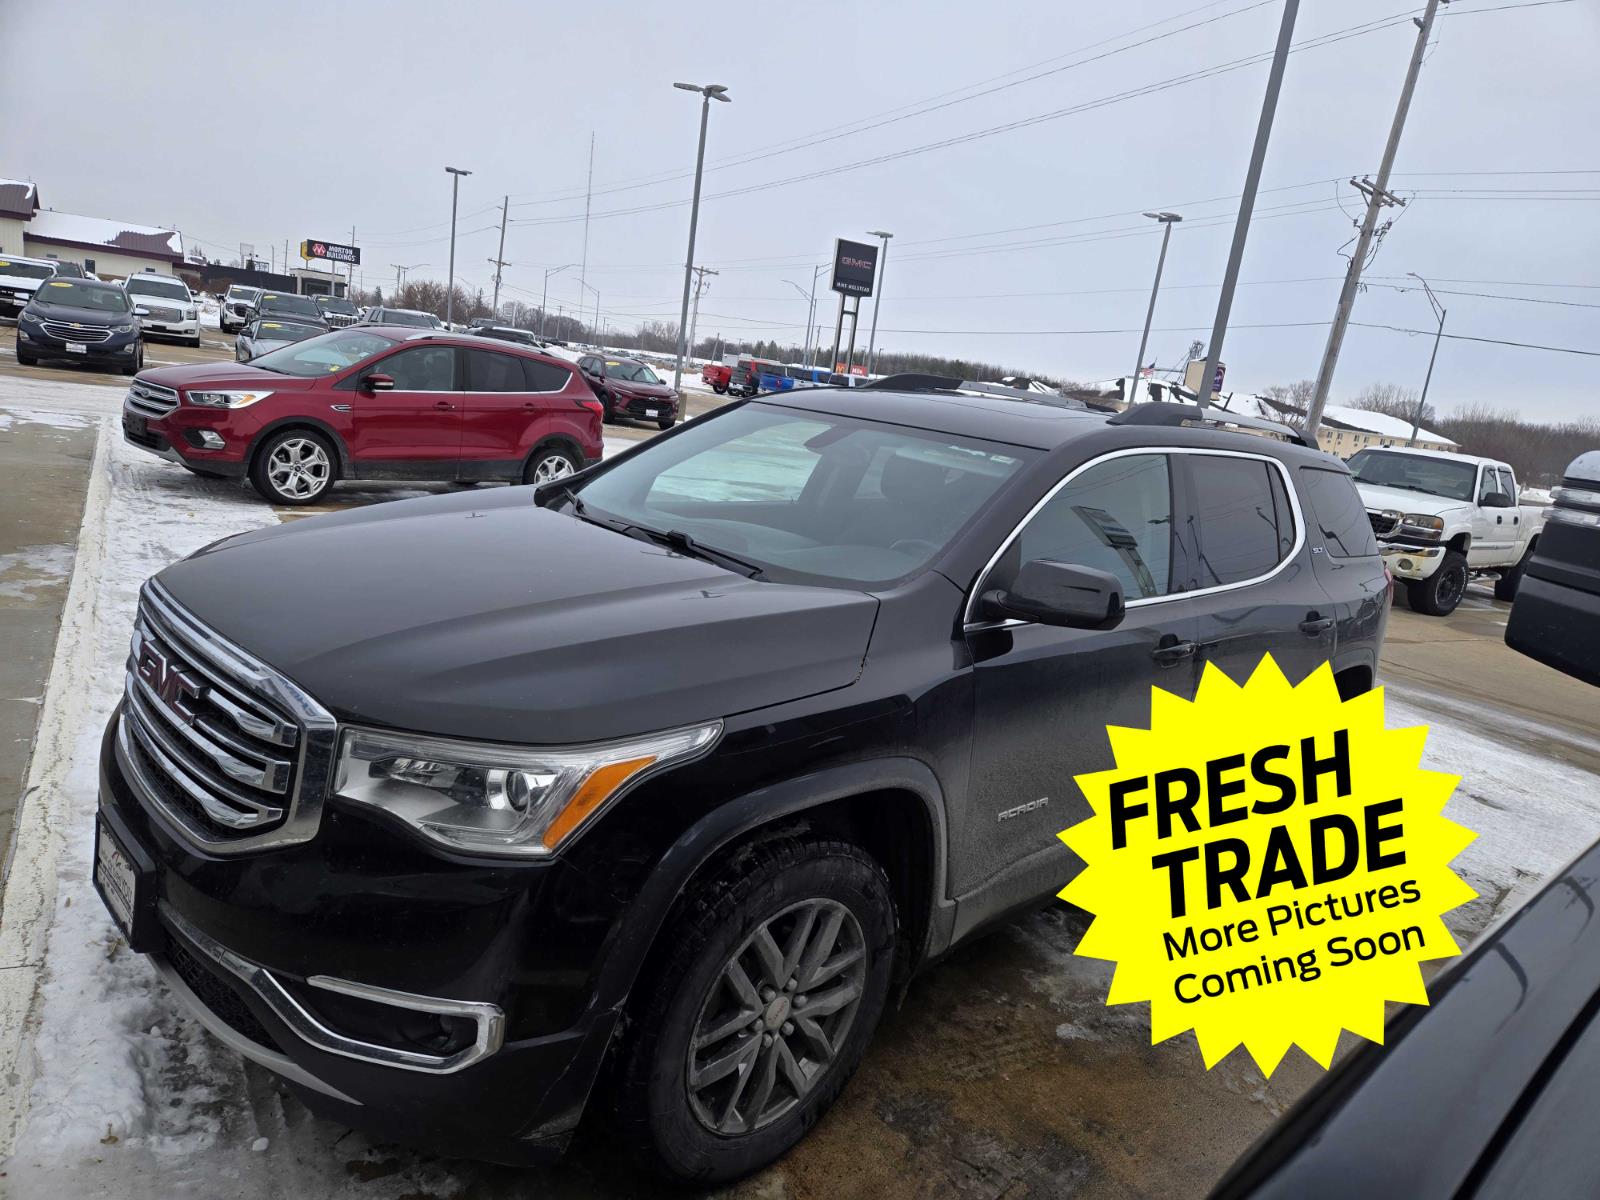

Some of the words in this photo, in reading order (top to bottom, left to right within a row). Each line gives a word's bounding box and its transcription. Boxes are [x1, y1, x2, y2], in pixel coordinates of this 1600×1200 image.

[329, 245, 353, 255] MORTON
[327, 251, 355, 262] BUILDINGS
[998, 797, 1049, 822] ACADIA
